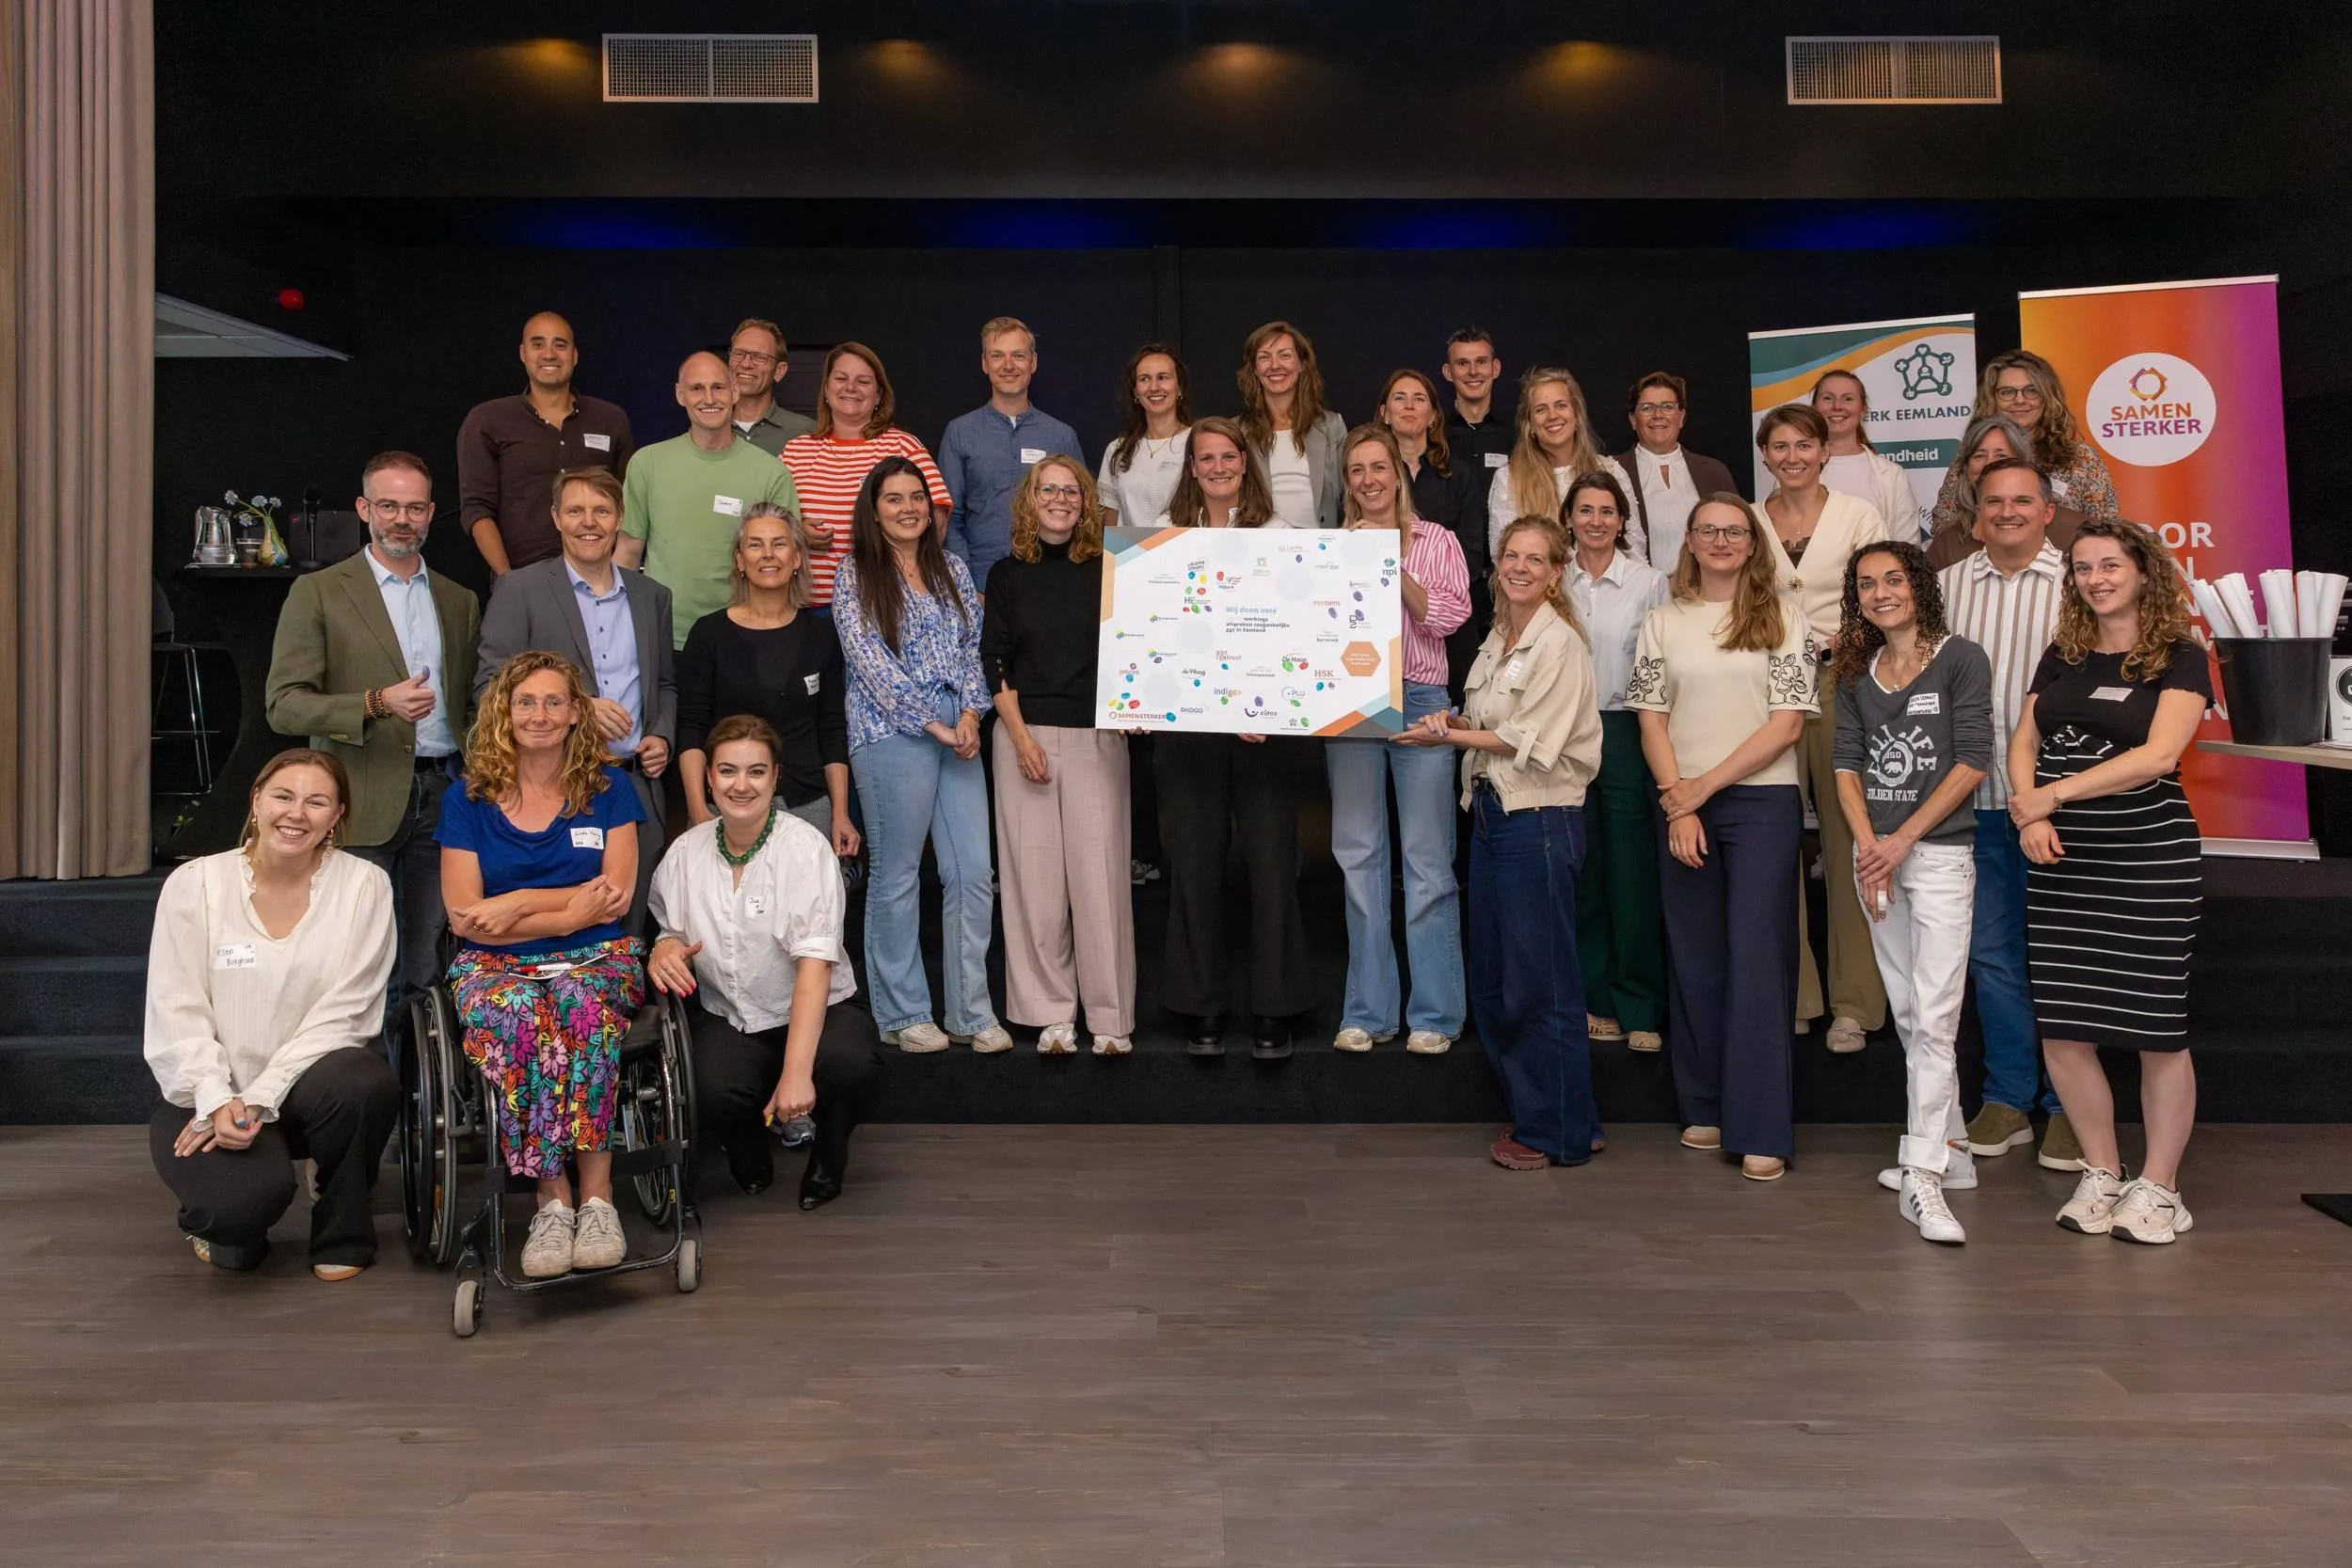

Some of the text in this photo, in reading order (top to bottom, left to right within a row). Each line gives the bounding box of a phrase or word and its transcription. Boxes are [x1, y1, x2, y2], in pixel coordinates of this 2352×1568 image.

[1896, 405, 1971, 420] EEMLAND
[2110, 403, 2192, 421] SAMEN
[2102, 419, 2202, 437] STERKER
[2137, 521, 2215, 549] OR
[1382, 567, 1397, 578] npi
[1226, 606, 1238, 614] Wij
[1314, 669, 1335, 678] HSK
